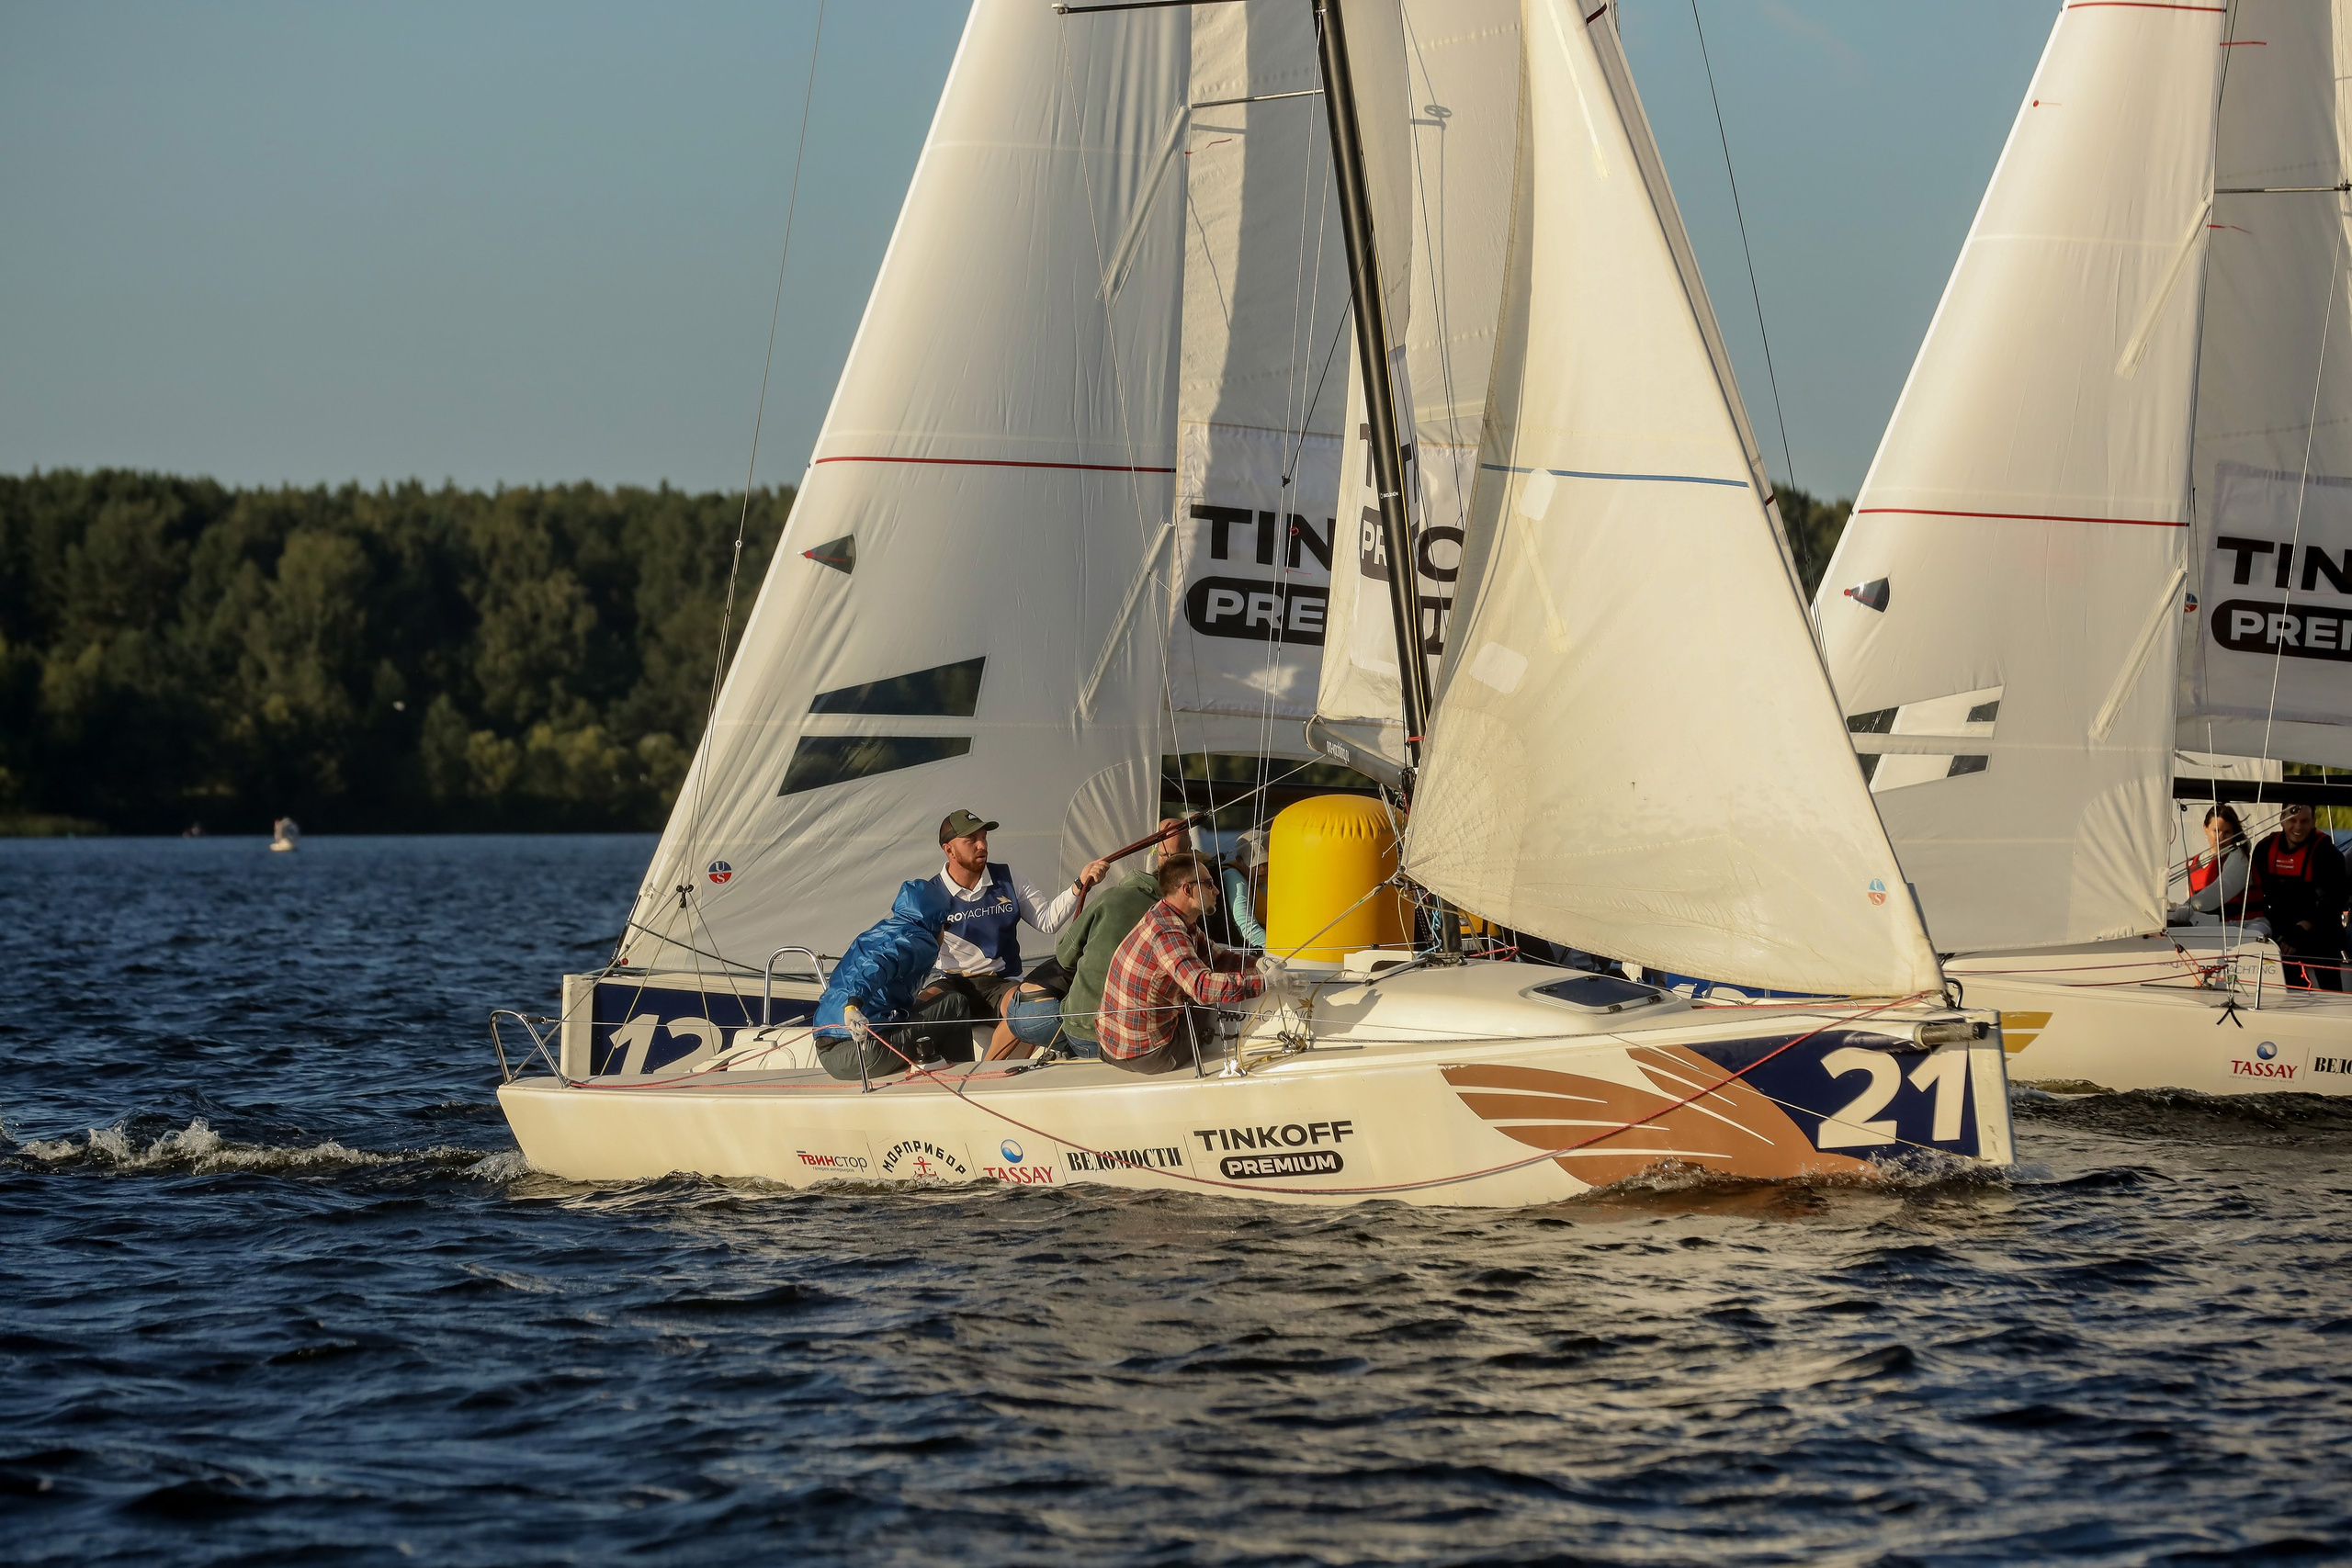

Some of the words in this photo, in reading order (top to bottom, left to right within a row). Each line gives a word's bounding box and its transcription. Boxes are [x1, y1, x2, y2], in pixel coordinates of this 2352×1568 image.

[2217, 536, 2352, 594] TIN
[609, 1013, 723, 1074] 12
[2231, 1060, 2298, 1078] TASSAY
[1817, 1043, 1968, 1148] 21
[1193, 1121, 1354, 1151] TINKOFF
[882, 1140, 967, 1174] МОРПРИБОР
[1066, 1146, 1184, 1173] ВЕДОМОСТИ
[1226, 1154, 1337, 1176] PREMIUM
[982, 1166, 1054, 1184] TASSAY
